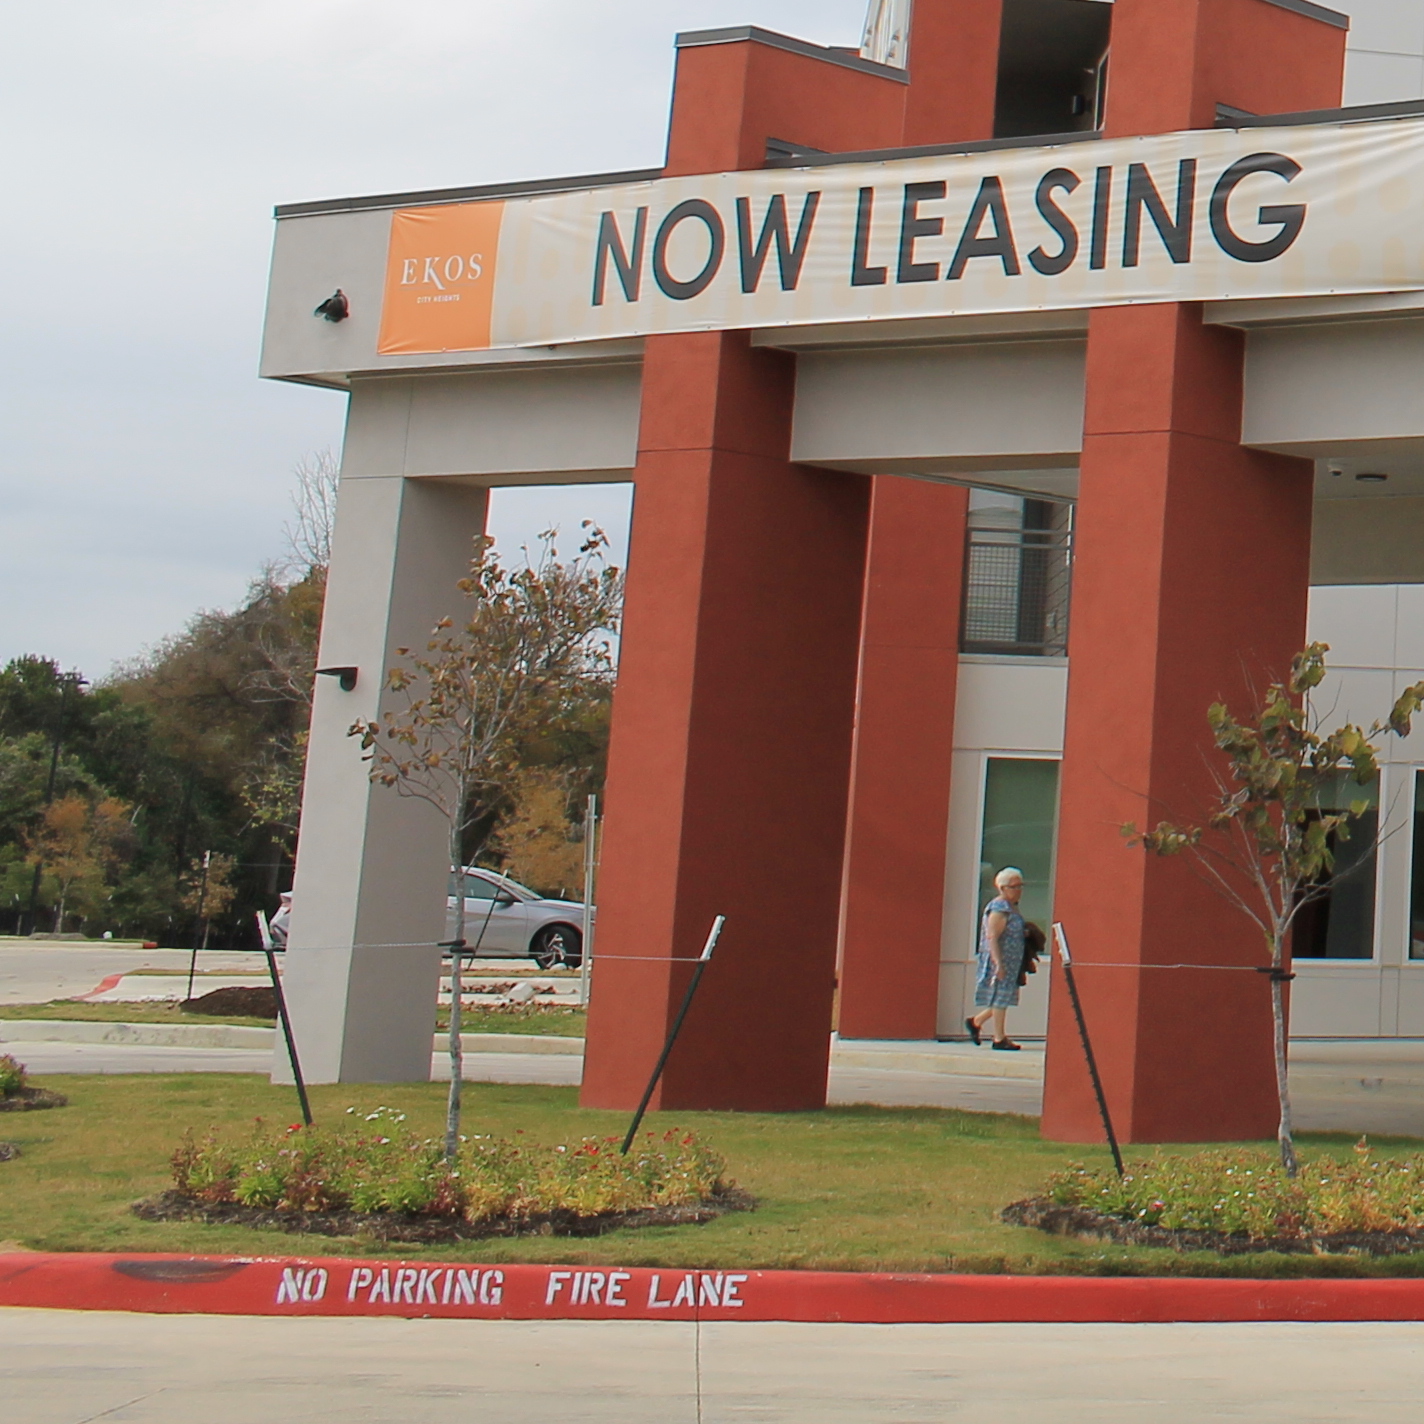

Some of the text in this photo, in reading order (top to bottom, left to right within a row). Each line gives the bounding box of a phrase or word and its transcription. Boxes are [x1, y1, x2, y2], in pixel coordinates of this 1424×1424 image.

[591, 152, 1308, 307] NOW LEASING
[400, 253, 483, 290] EKOS
[417, 294, 460, 304] CITY HEIGHTS
[276, 1267, 748, 1309] NO PARKING FIRE LANE
